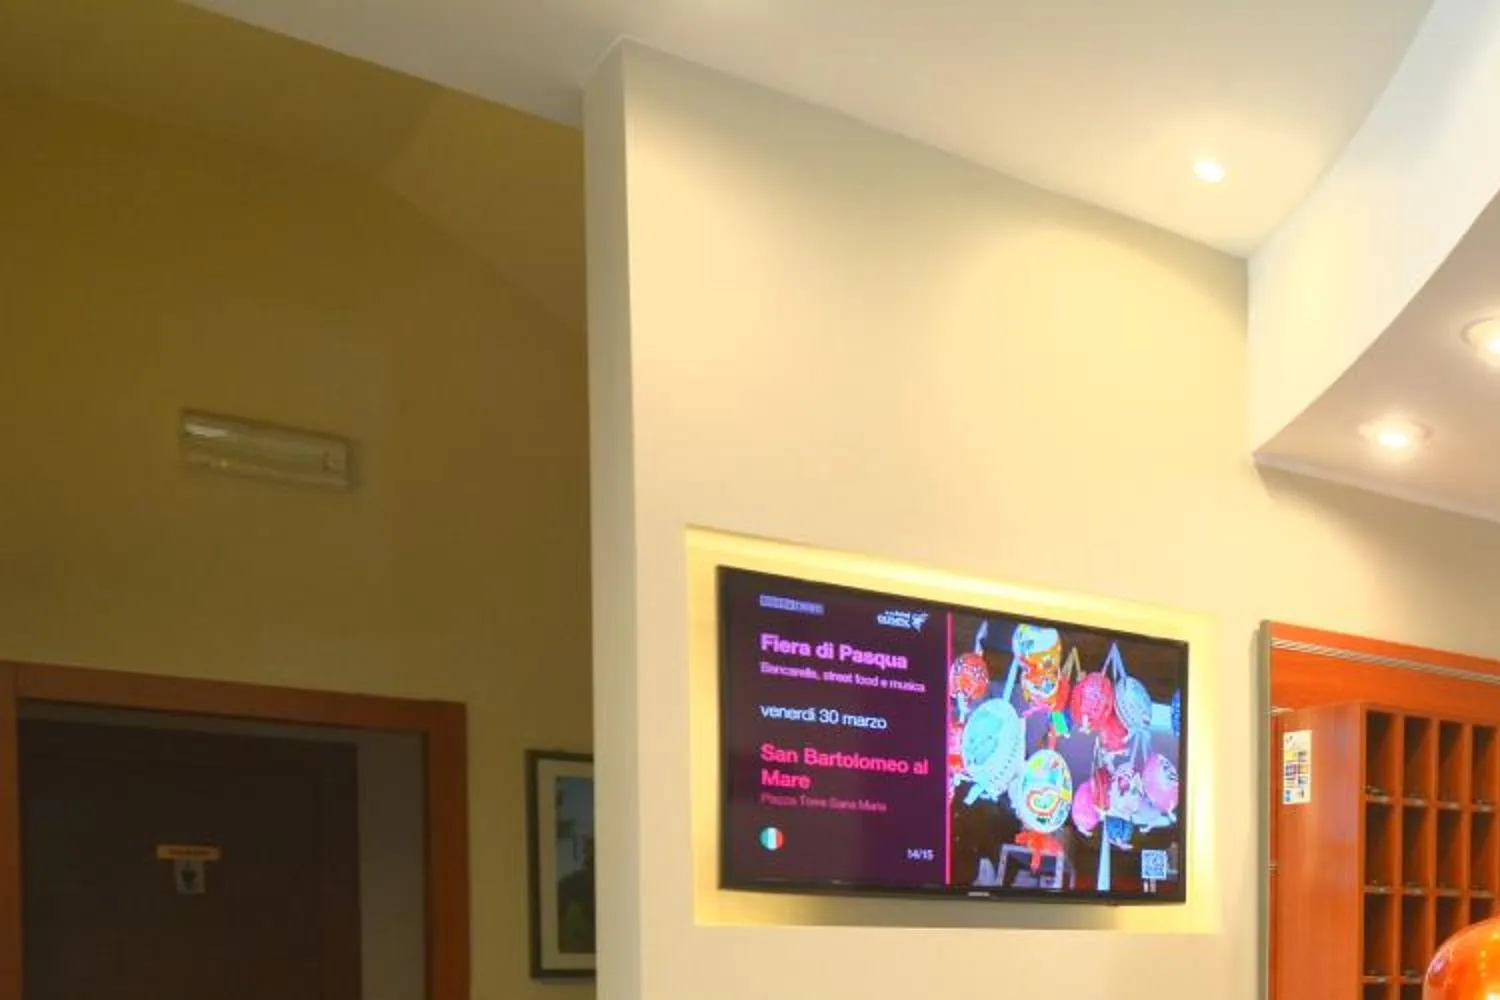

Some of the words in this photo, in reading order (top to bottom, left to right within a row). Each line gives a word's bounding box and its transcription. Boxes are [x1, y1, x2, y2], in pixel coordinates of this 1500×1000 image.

[760, 633, 811, 657] Fiera
[815, 641, 835, 660] di
[839, 644, 908, 670] Pasqua
[890, 679, 926, 693] musica
[819, 708, 839, 724] 30
[842, 714, 887, 730] marzo
[760, 743, 798, 764] San
[803, 747, 909, 773] Bartolomeo
[912, 758, 929, 775] al
[761, 767, 811, 790] Mare
